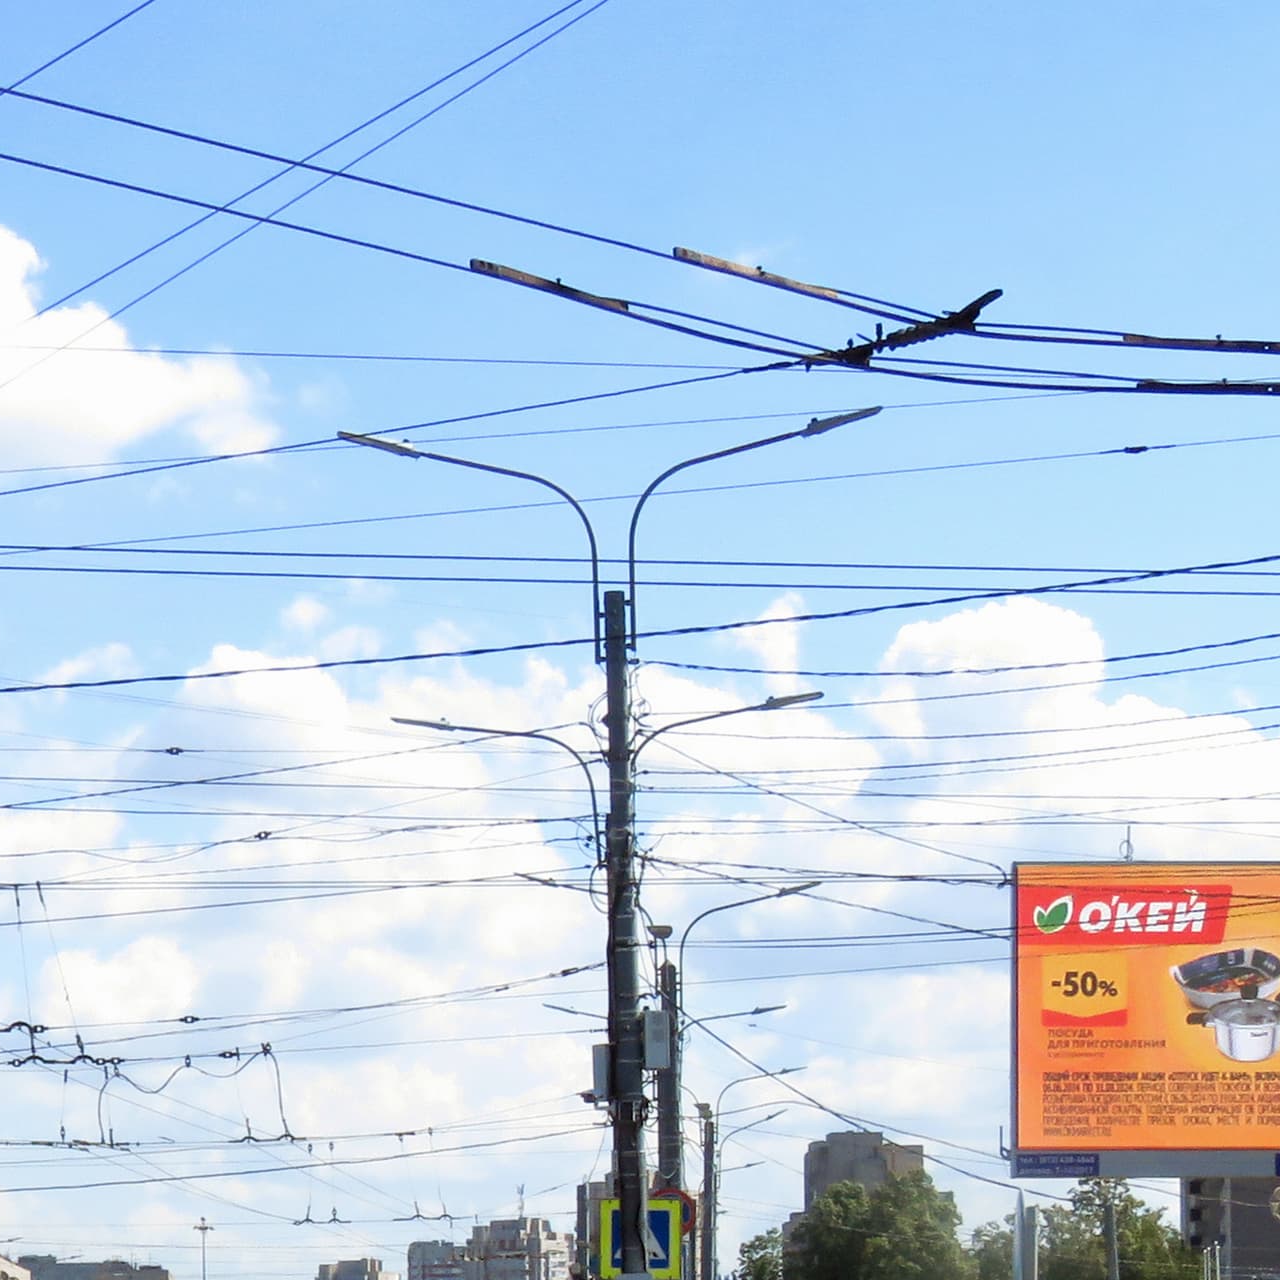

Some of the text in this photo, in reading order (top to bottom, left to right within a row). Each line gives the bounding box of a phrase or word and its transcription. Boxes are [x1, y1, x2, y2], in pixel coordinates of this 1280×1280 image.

[1051, 971, 1118, 997] -50%
[1047, 1029, 1094, 1038] ПОСУДА
[1047, 1039, 1166, 1049] ДЛЯ ПРИГОТОВЛЕНИЯ
